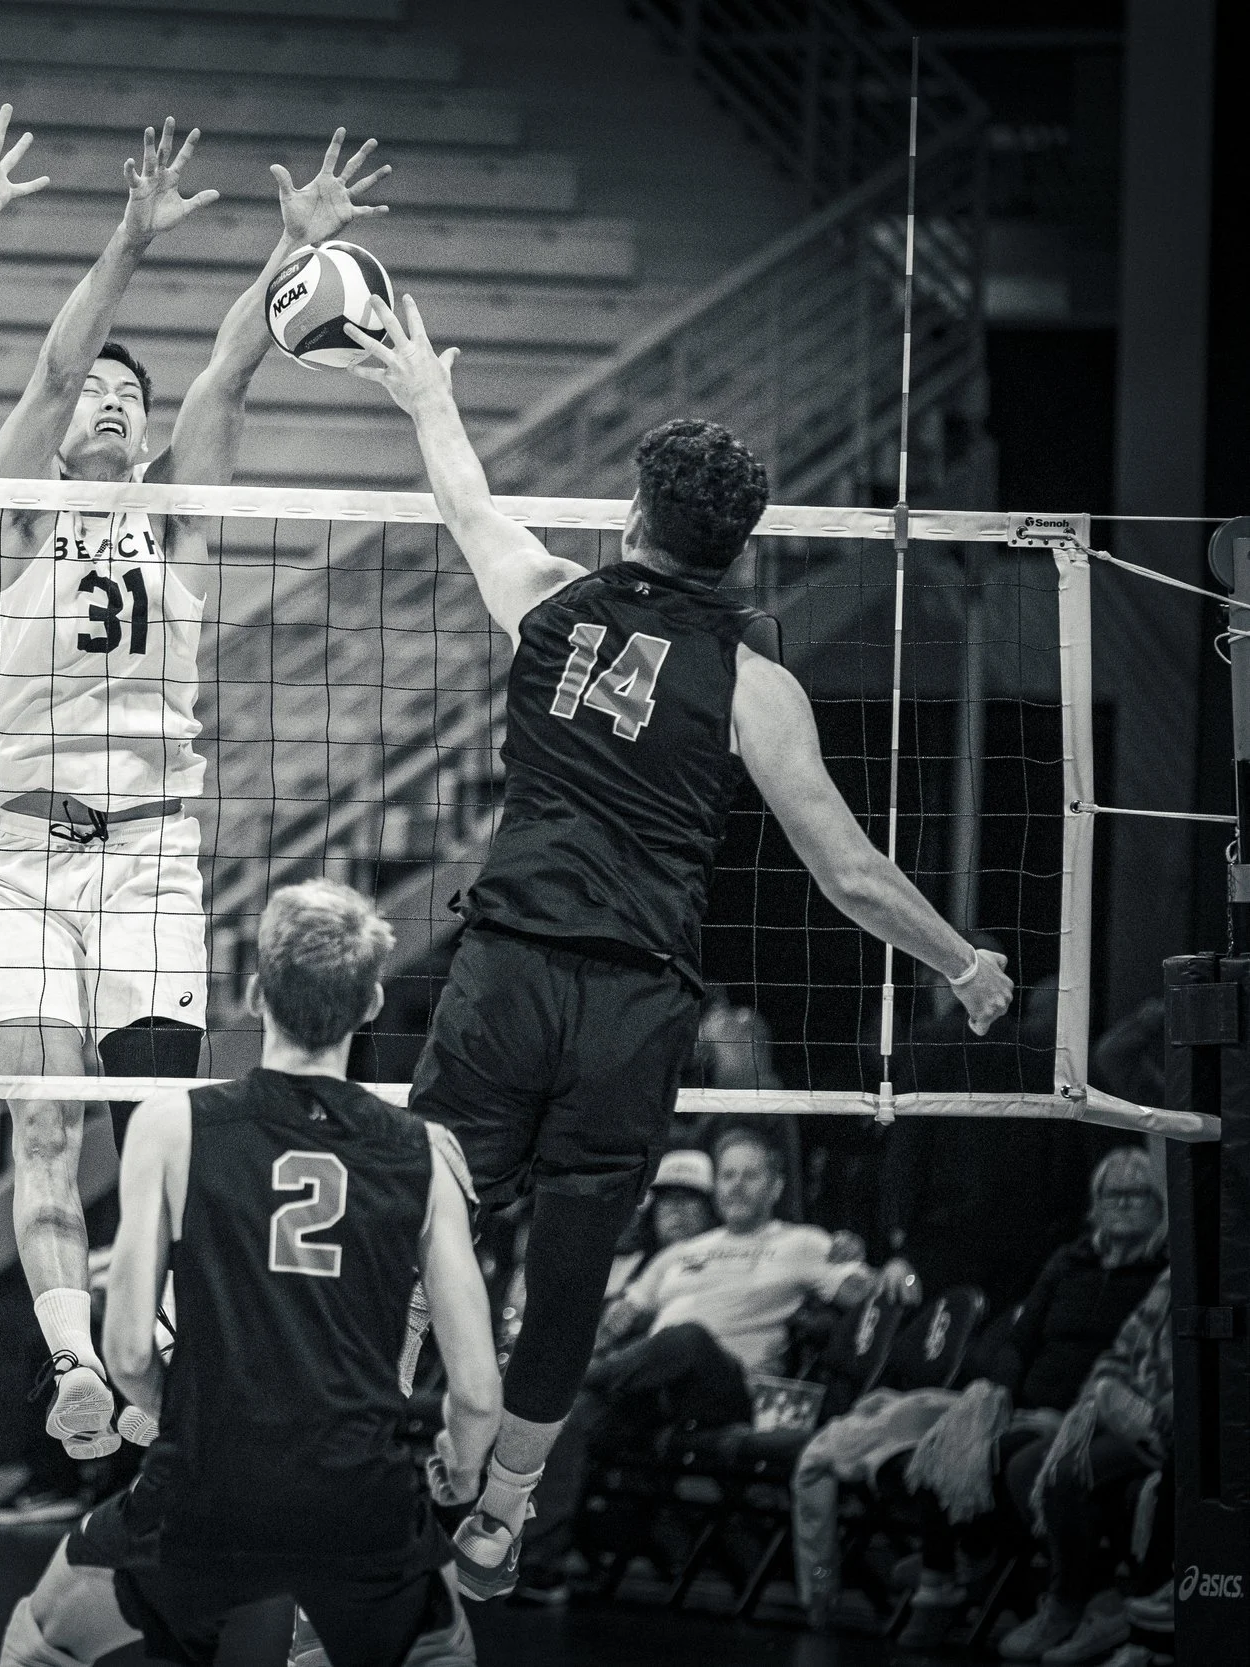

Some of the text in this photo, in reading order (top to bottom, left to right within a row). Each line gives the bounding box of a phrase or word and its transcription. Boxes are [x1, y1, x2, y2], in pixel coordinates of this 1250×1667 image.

[273, 282, 308, 318] NCAA
[1036, 518, 1070, 528] Senoh
[77, 567, 148, 655] 31
[549, 622, 671, 742] 14
[268, 1149, 348, 1278] 2
[1199, 1573, 1242, 1598] asics
